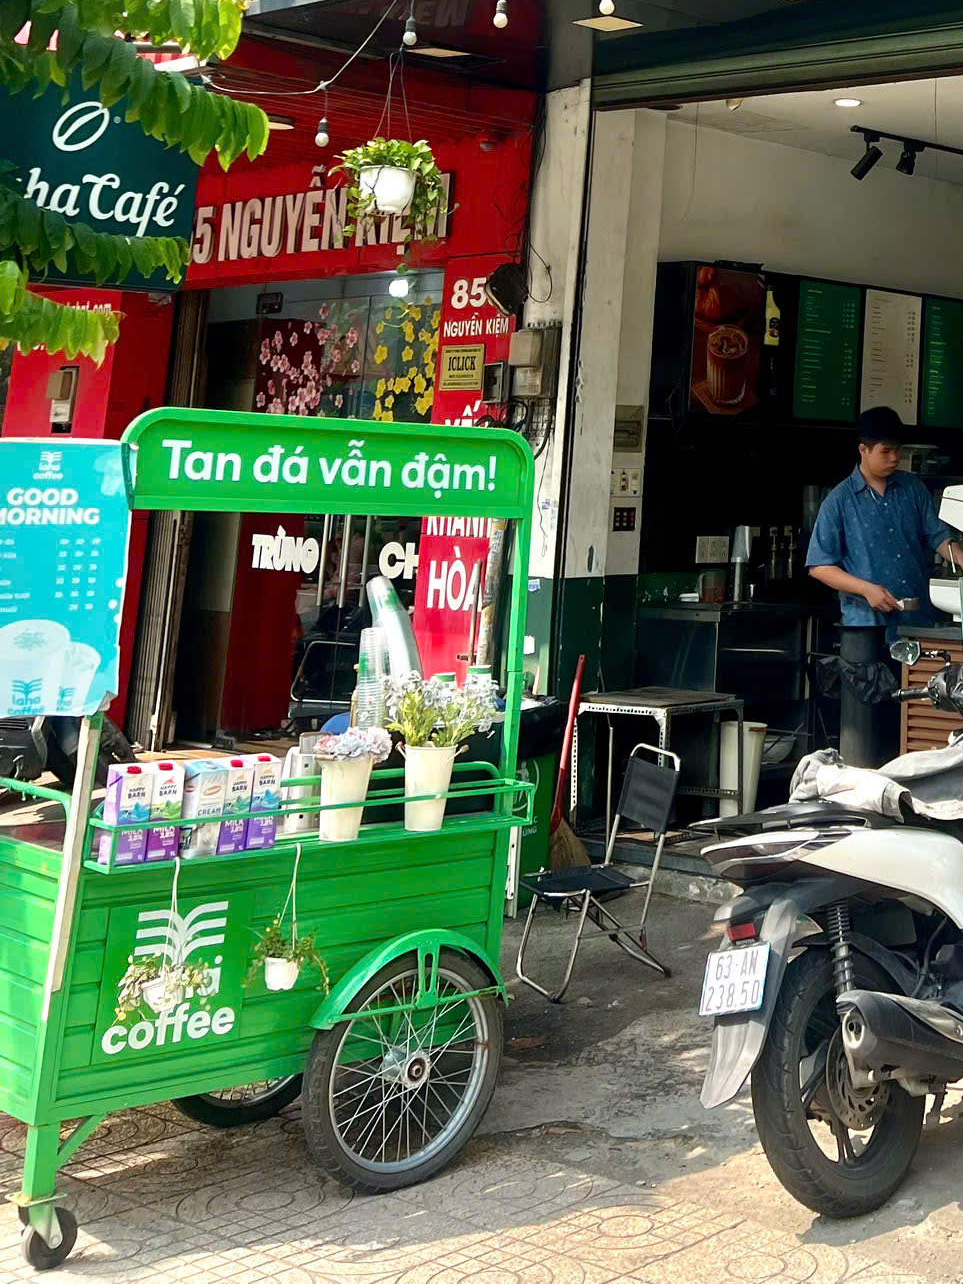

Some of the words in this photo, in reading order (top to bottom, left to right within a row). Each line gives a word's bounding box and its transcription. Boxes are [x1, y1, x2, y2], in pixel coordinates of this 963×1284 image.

[82, 173, 186, 240] Café
[217, 163, 348, 263] NGUYỄN
[451, 277, 495, 310] 85
[447, 355, 477, 372] ICLICK
[162, 439, 242, 482] Tan
[252, 444, 310, 485] đá
[318, 438, 393, 488] vẫn
[400, 452, 497, 500] đậm!
[7, 487, 79, 507] GOOD
[426, 545, 484, 613] HÒA
[128, 791, 146, 799] BARN
[197, 806, 222, 816] CREAM
[705, 979, 761, 1012] 238.50
[100, 1002, 236, 1055] coffee
